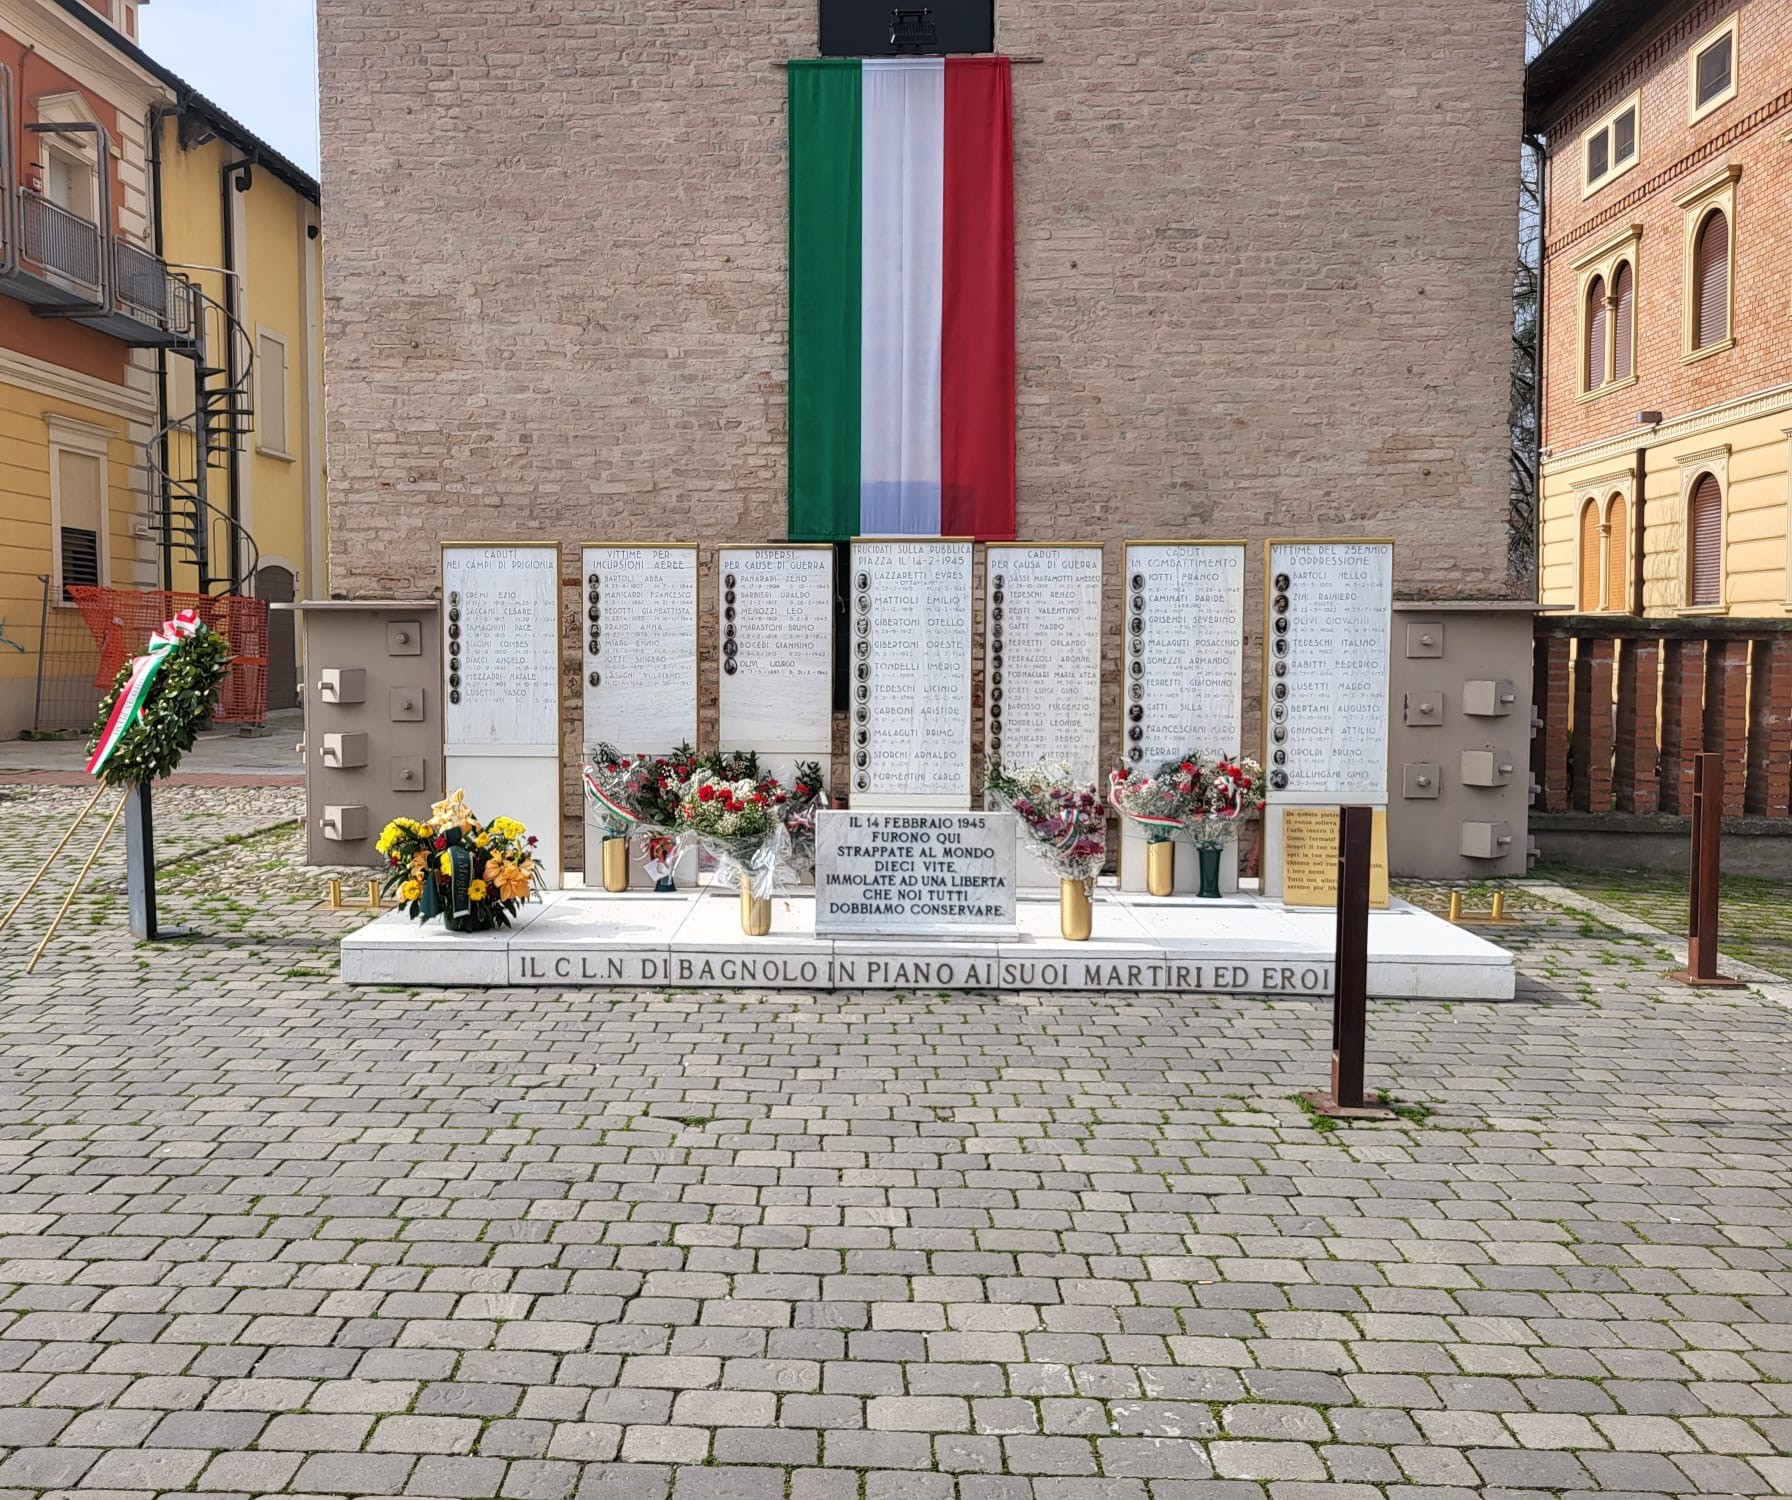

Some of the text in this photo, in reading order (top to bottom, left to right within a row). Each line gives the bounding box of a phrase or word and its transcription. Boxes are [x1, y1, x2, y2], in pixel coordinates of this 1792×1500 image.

[484, 550, 516, 558] CADUTI
[854, 546, 970, 554] TRUCIDATI SULLA PUBBLICA
[1166, 548, 1204, 556] CADUTI
[1273, 546, 1388, 554] VITTIME DEL 25ENNIO
[756, 551, 794, 559] DISPERSI
[594, 561, 684, 569] INCURSIONI AEREE
[859, 557, 964, 565] PIAZZA IL 14-2-1945
[1132, 559, 1237, 567] IN COMBATTIMENTO
[1291, 557, 1370, 565] D'OPPRESSIONE
[1145, 748, 1179, 756] FERRARI
[849, 817, 985, 828] IL 14 FEBBRAIO 1945
[872, 832, 960, 844] FURONO QUI
[837, 847, 994, 858] STRAPPATE AL MONDO
[875, 861, 957, 872] DIECI VITE,
[827, 875, 895, 886] IMMOLATE
[900, 875, 918, 886] AD
[922, 875, 946, 886] UNA
[863, 890, 968, 900] CHE NOI TUTTI
[830, 903, 1005, 915] DOBBIAMO CONSERVARE.
[520, 957, 545, 978] IL
[641, 958, 669, 979] DI
[678, 959, 817, 981] BAGNOLO
[827, 961, 855, 981] IN
[867, 962, 954, 983] PIANO
[964, 964, 993, 985] AI
[1002, 963, 1068, 986] SUOI
[1084, 964, 1202, 988] MARTIRI
[1214, 967, 1249, 988] ED
[1262, 968, 1330, 990] EROI
